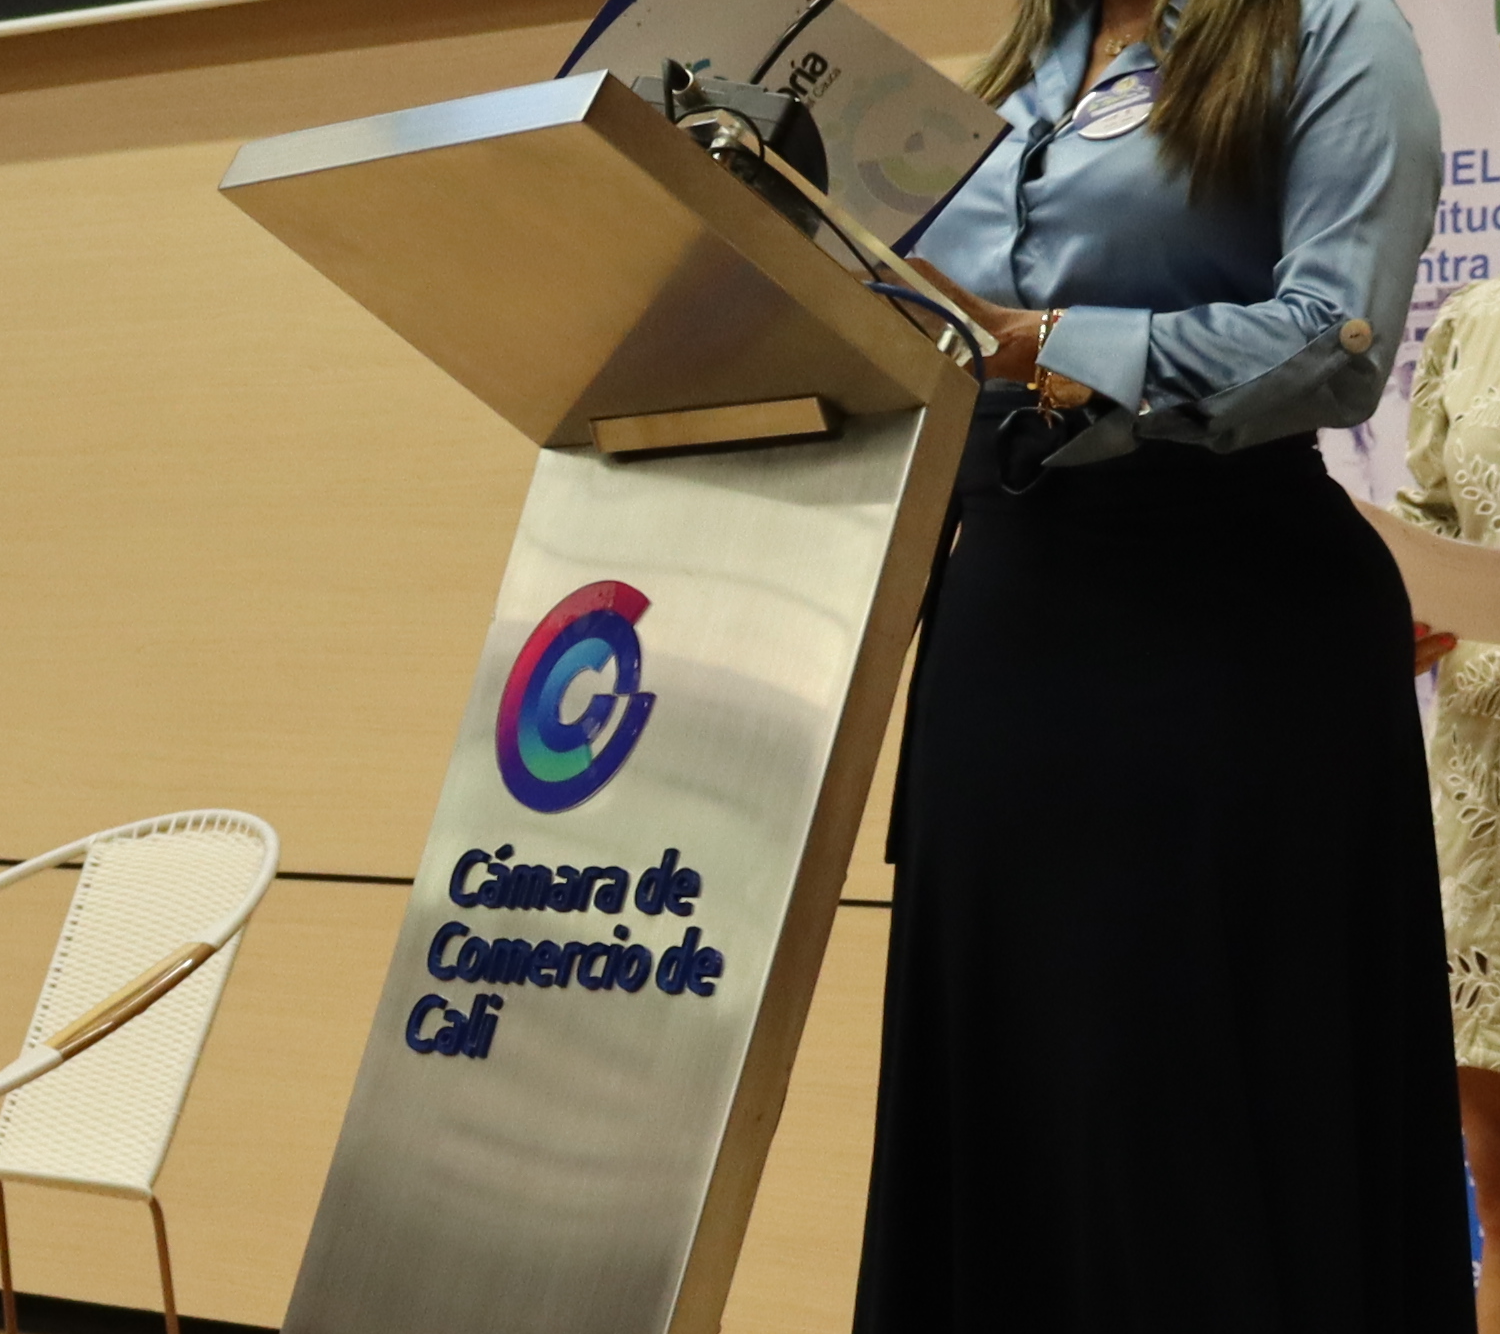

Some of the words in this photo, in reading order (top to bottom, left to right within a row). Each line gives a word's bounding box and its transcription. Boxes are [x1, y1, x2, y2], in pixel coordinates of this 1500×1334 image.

[448, 842, 630, 916] Cámara
[635, 847, 703, 917] de
[427, 920, 653, 994] Comercio
[655, 925, 725, 998] de
[405, 992, 504, 1060] Cali
